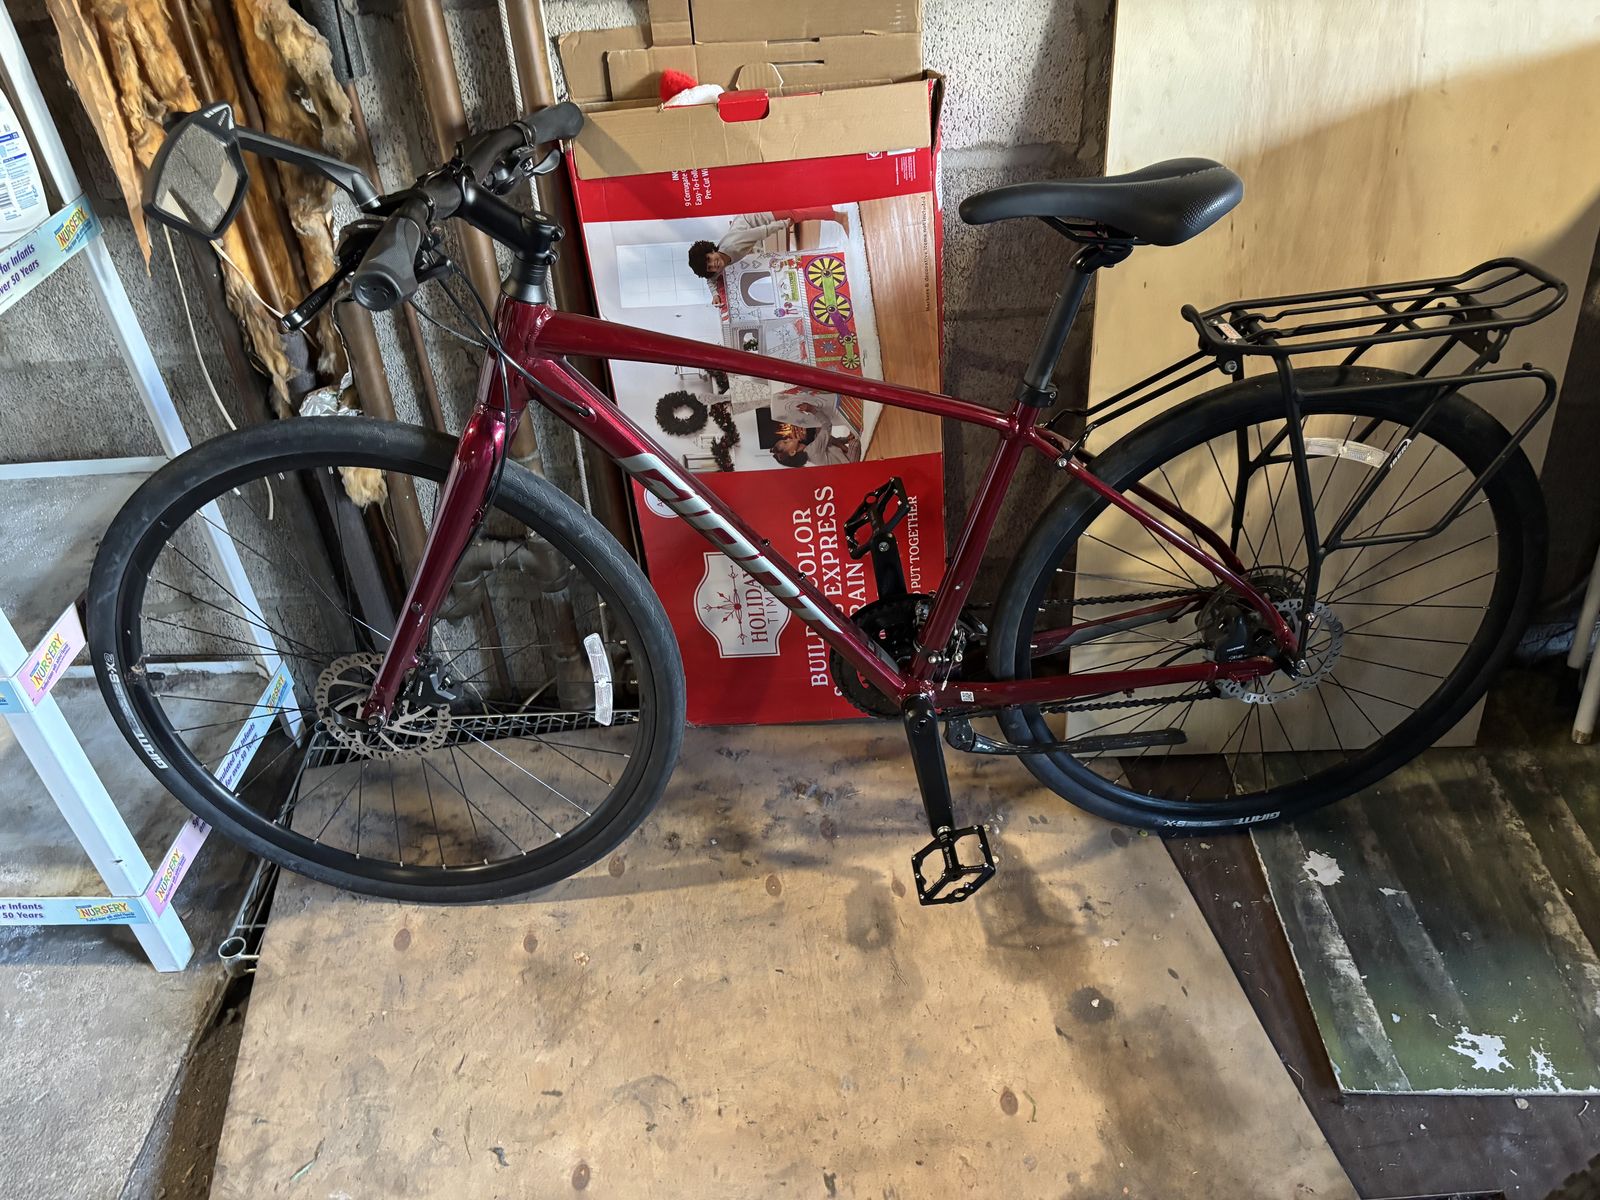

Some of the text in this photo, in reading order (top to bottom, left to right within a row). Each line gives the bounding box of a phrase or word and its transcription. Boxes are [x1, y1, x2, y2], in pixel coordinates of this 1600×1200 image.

[58, 206, 87, 248] NURSERY
[10, 243, 36, 267] Infants
[10, 272, 20, 286] 50
[20, 259, 40, 278] Years
[814, 485, 843, 596] EXPRESS
[845, 562, 868, 617] RAIN
[909, 566, 921, 589] PUT
[33, 633, 63, 686] NURSERY
[132, 732, 169, 769] GIANT
[158, 848, 180, 899] NURSERY
[9, 902, 44, 910] Infants
[16, 911, 44, 919] Years
[80, 902, 129, 918] NURSERY
